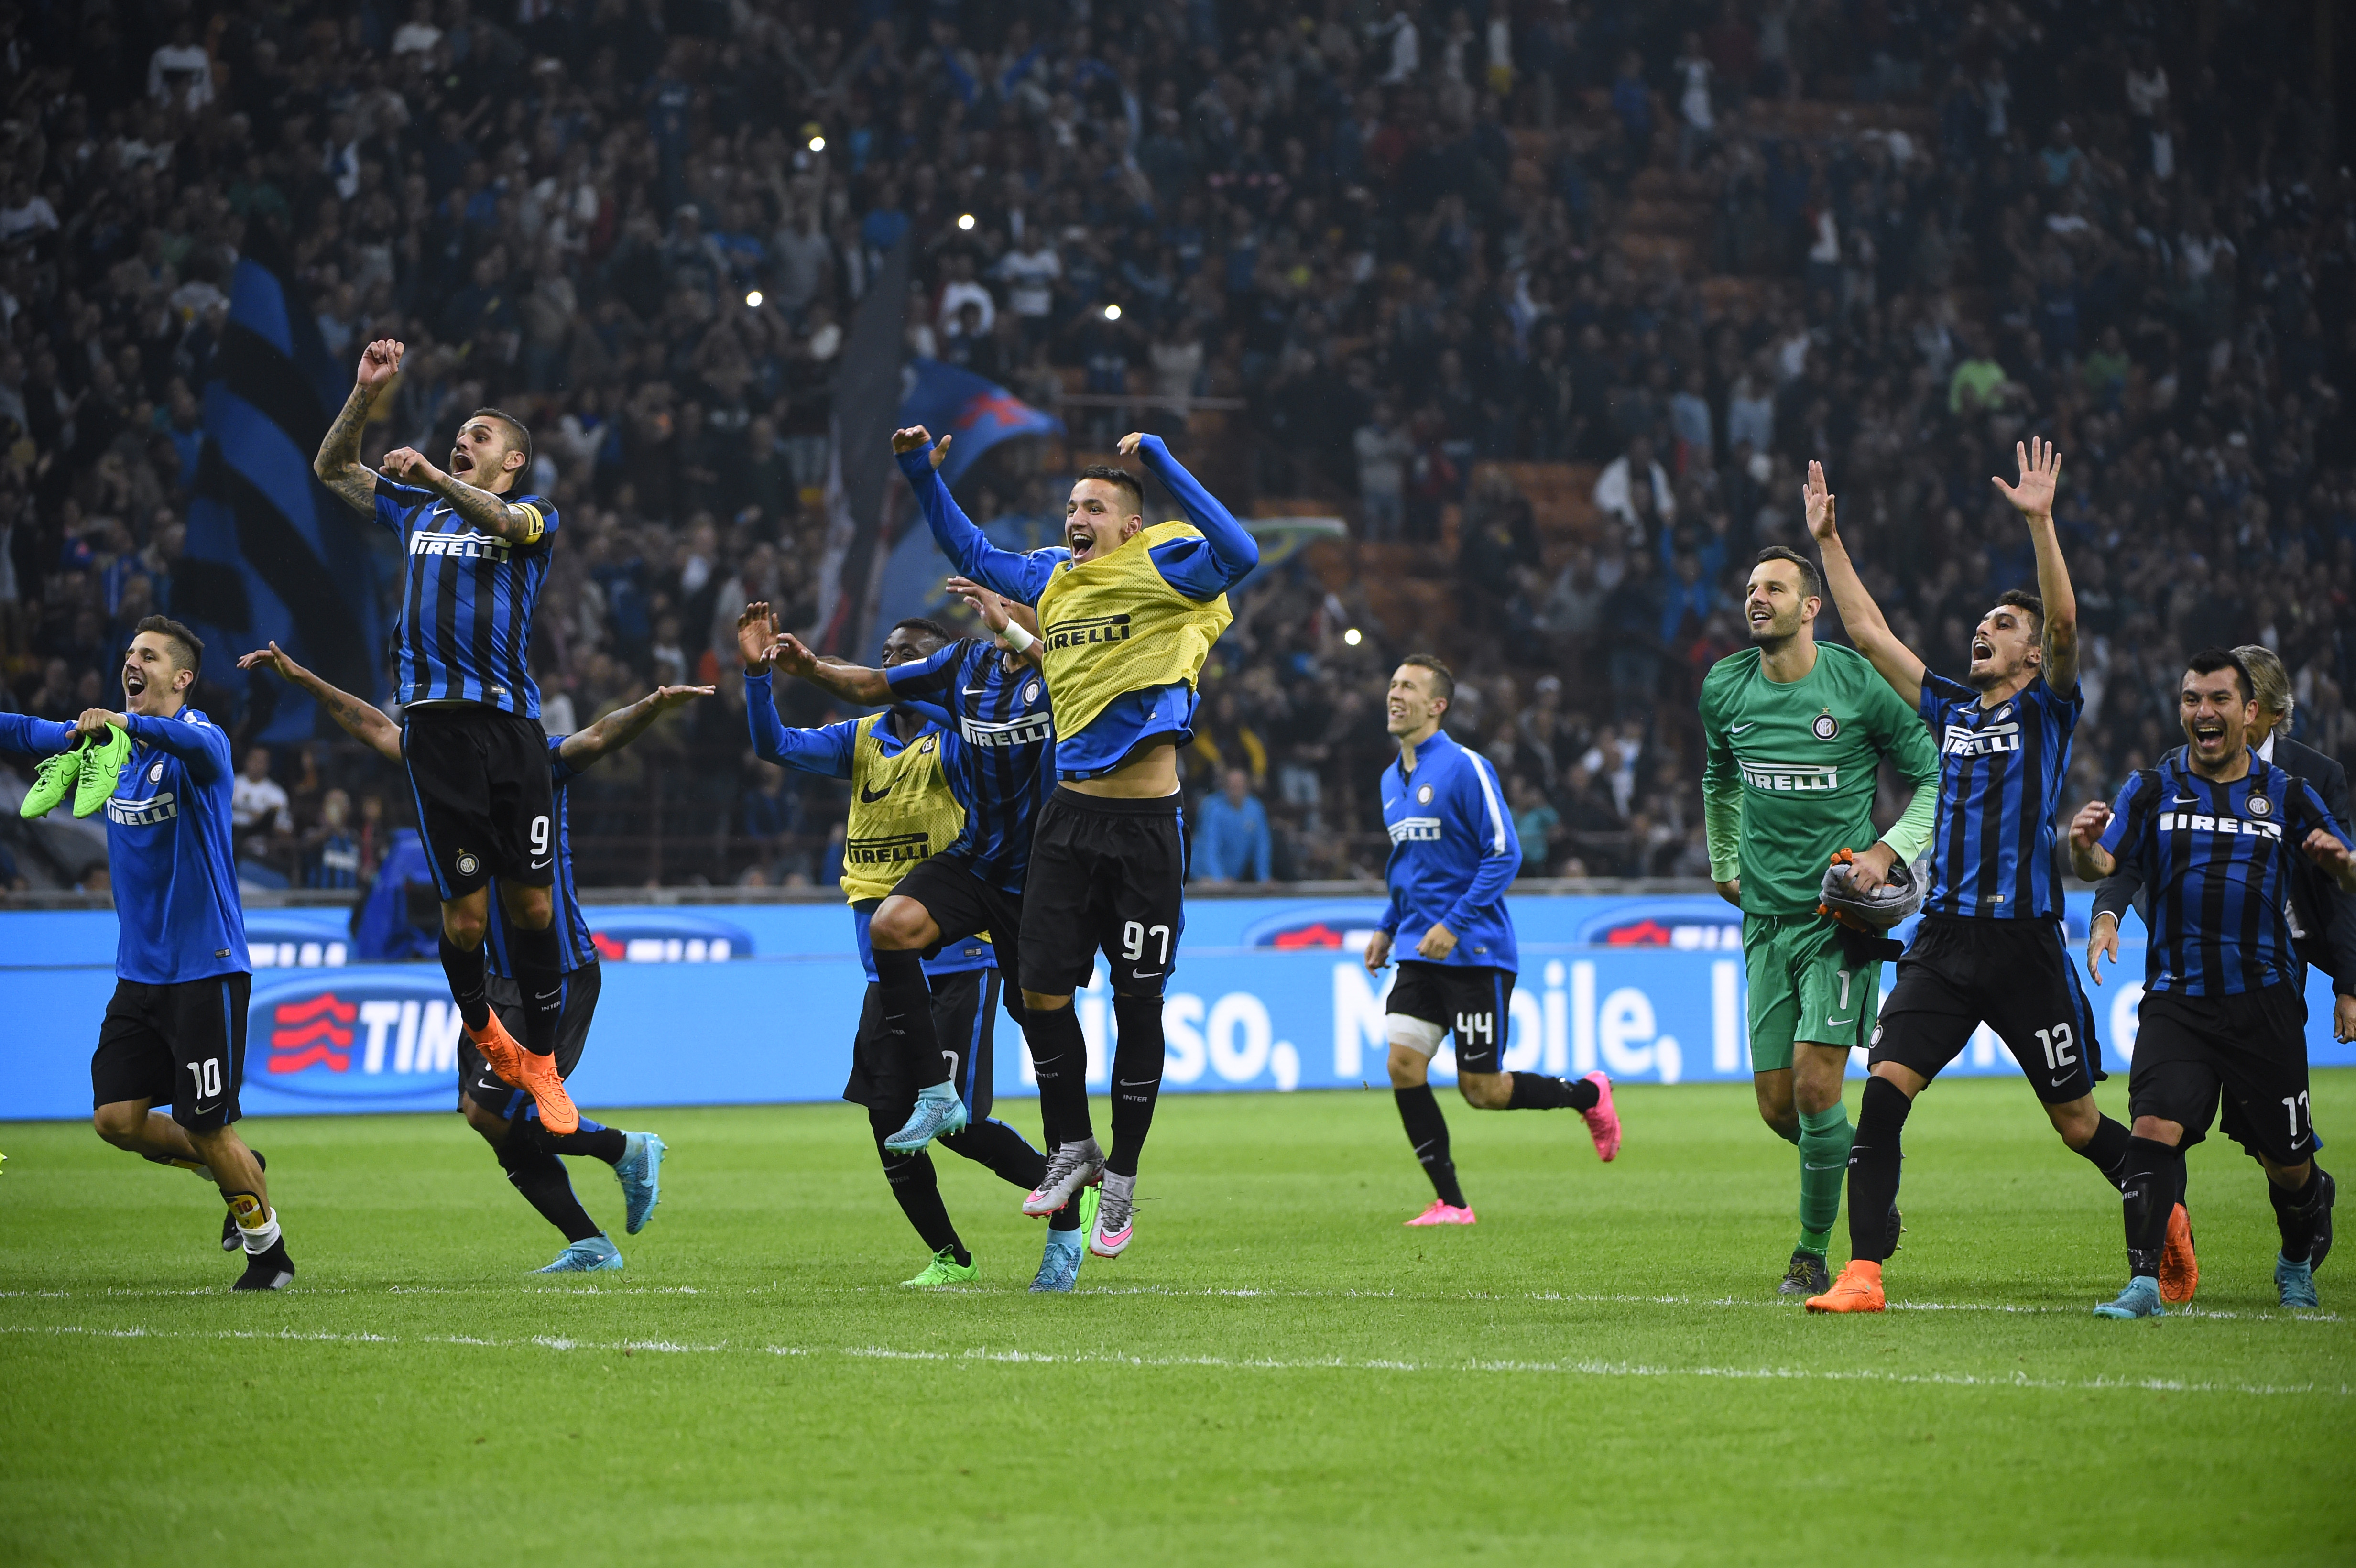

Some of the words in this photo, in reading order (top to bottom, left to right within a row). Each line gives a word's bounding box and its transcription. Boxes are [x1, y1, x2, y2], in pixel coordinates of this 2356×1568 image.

[410, 531, 512, 564] PIRELLI
[1043, 614, 1131, 654] PIRELLI
[960, 711, 1051, 747] PIRELLI
[1942, 722, 2019, 756] PIRELLI
[1736, 759, 1838, 790] PIRELLI
[106, 792, 178, 826] PIRELLI
[530, 815, 549, 855] 9
[847, 832, 929, 864] PIRELLI
[1122, 920, 1169, 965] 97
[541, 1001, 560, 1012] INTER
[1837, 970, 1850, 1010] 1
[359, 999, 463, 1074] TIM
[1456, 1012, 1493, 1046] 44
[2034, 1023, 2077, 1070] 12
[186, 1057, 222, 1100] 10
[1123, 1094, 1148, 1103] INTER
[2281, 1089, 2311, 1137] 17
[236, 1200, 253, 1214] 10
[2123, 1190, 2138, 1199] TER
